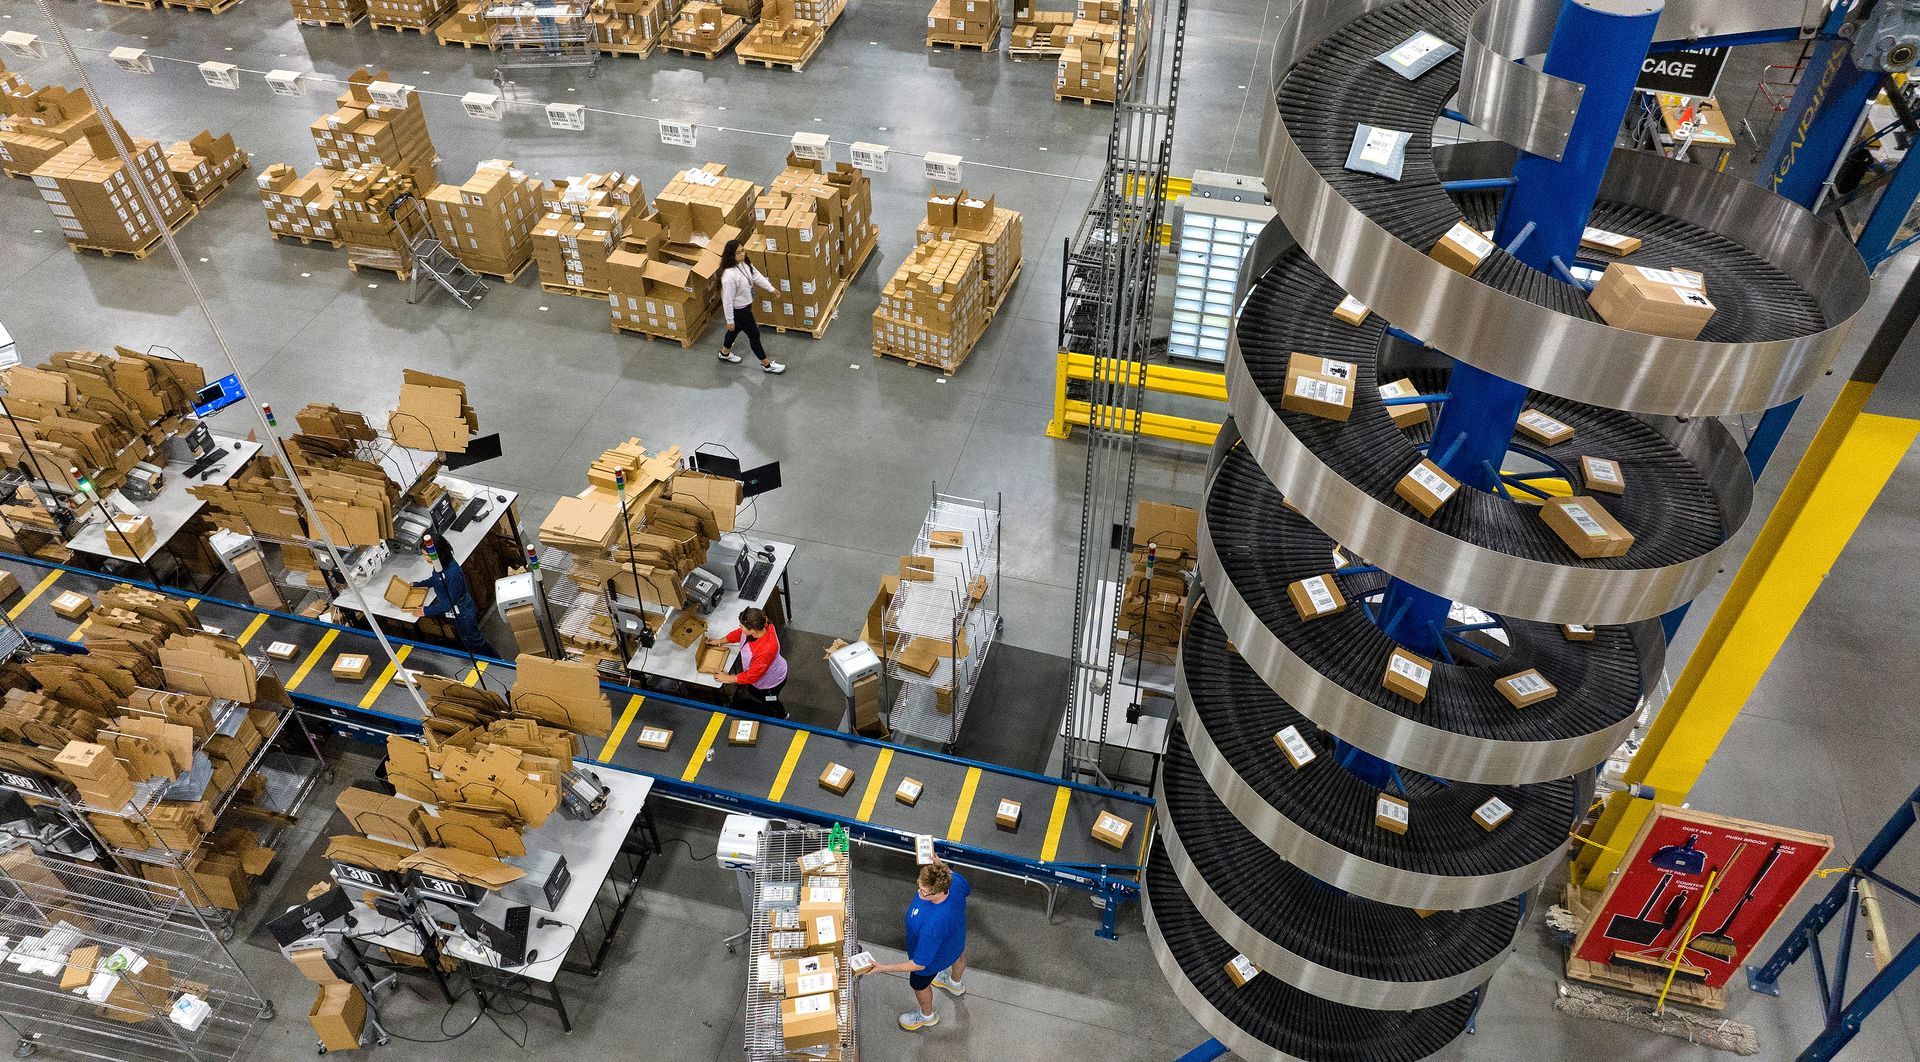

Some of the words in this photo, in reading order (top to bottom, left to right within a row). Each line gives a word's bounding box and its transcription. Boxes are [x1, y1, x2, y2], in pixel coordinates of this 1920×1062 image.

[1641, 58, 1696, 78] CAGE
[1743, 837, 1767, 846] BROOM
[346, 866, 374, 884] 310
[431, 879, 456, 895] 311
